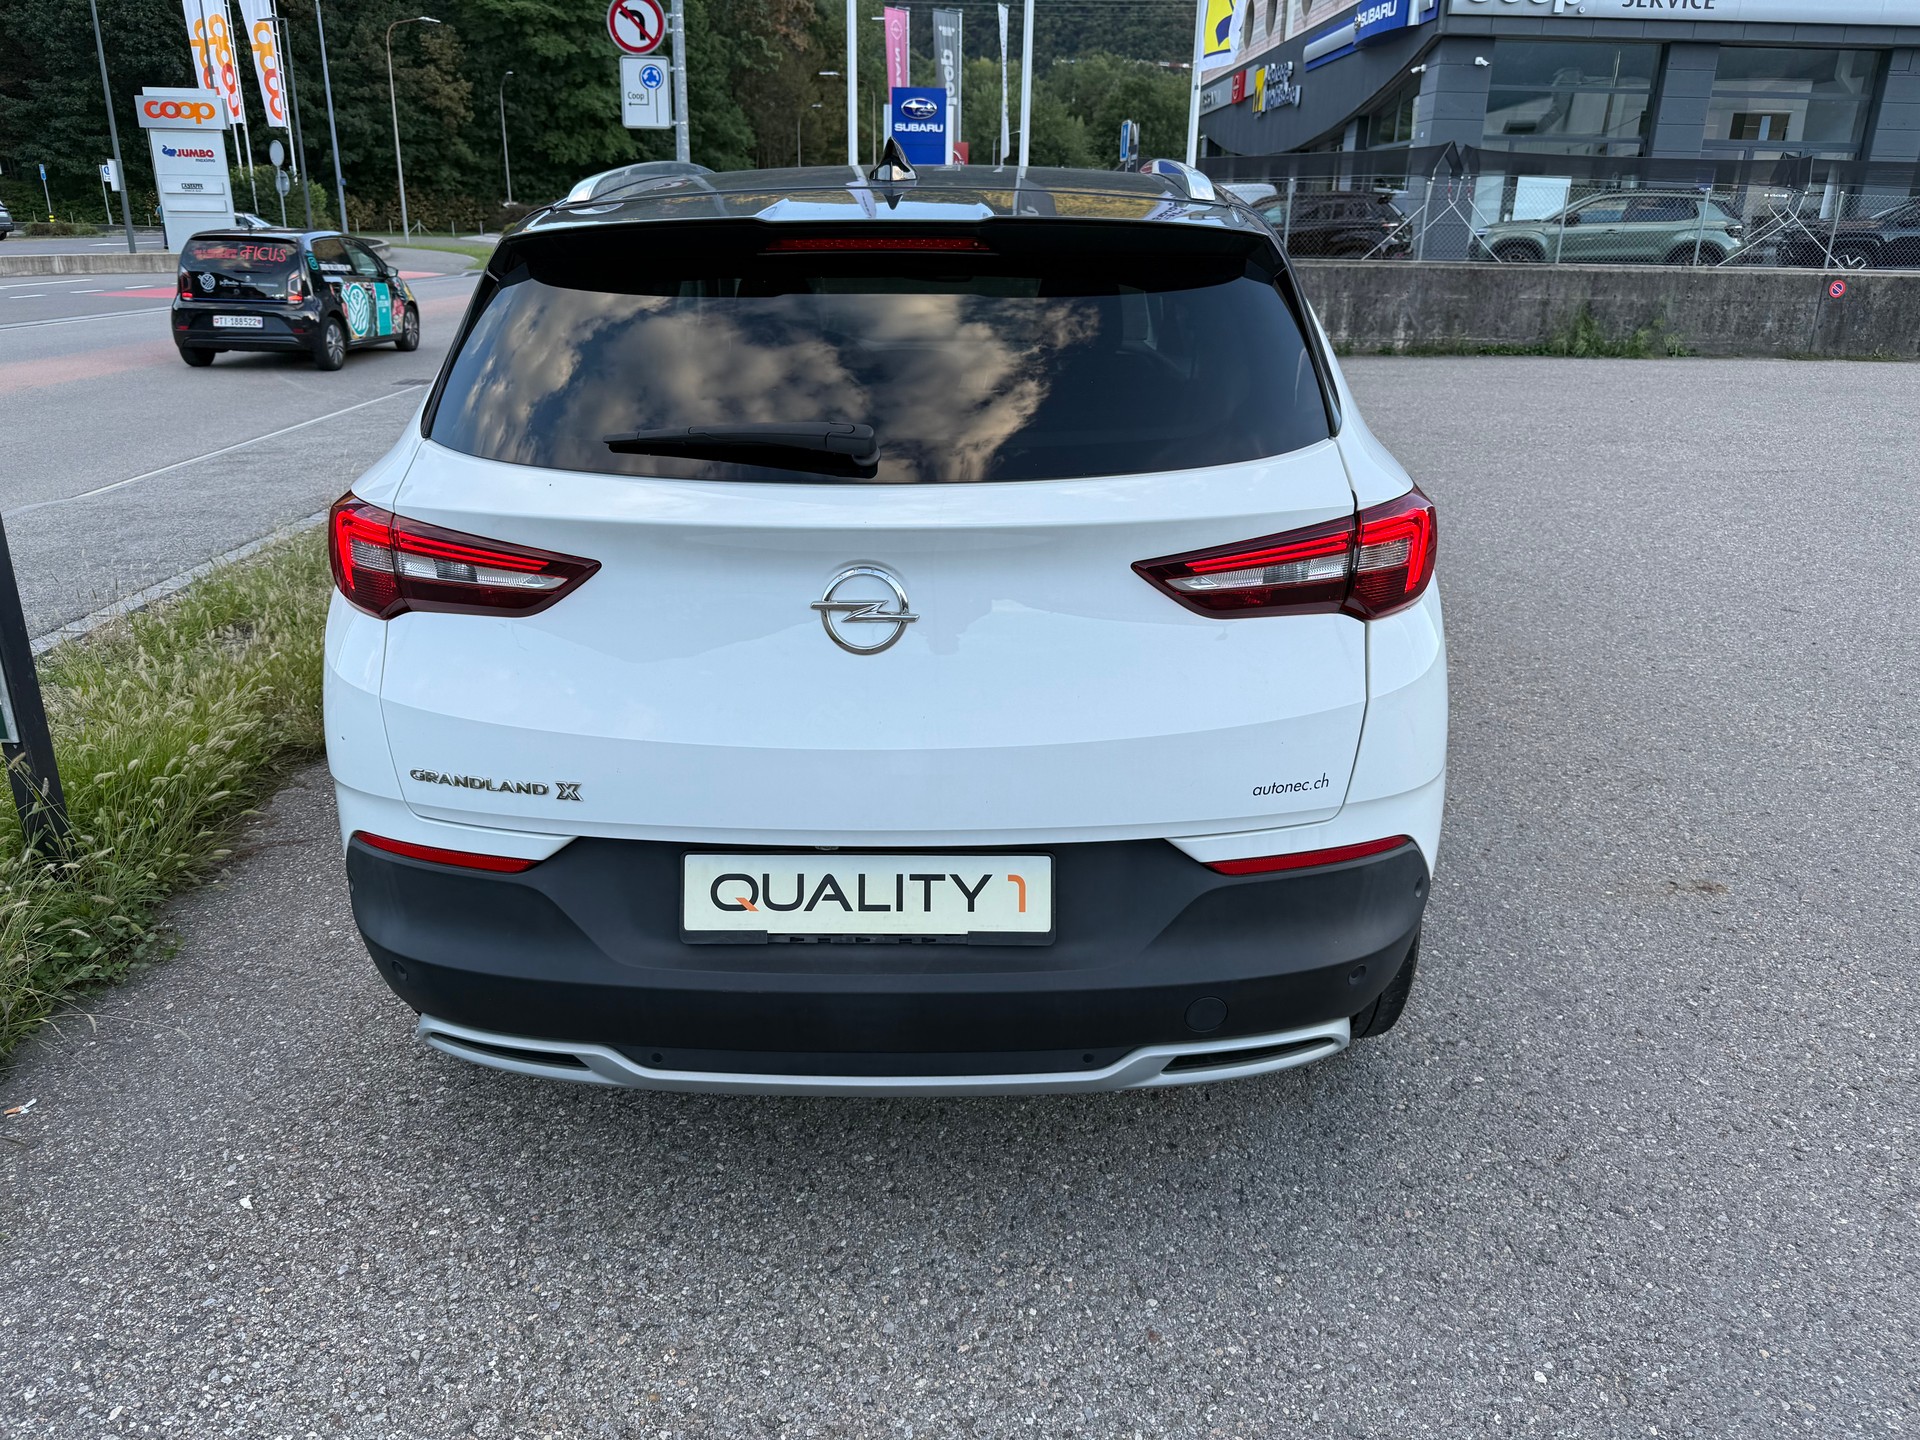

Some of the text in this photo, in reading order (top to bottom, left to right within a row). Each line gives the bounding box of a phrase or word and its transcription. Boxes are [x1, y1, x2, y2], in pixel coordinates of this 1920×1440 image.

[1361, 0, 1397, 27] SUBARU
[627, 91, 645, 101] Coop
[143, 100, 216, 125] coop
[894, 123, 944, 133] SUBARU
[176, 148, 214, 158] JUMBO
[240, 245, 287, 263] FICUS
[409, 767, 585, 802] GRANDLAND X
[1252, 772, 1330, 796] autonec.ch
[710, 873, 993, 913] QUALITY
